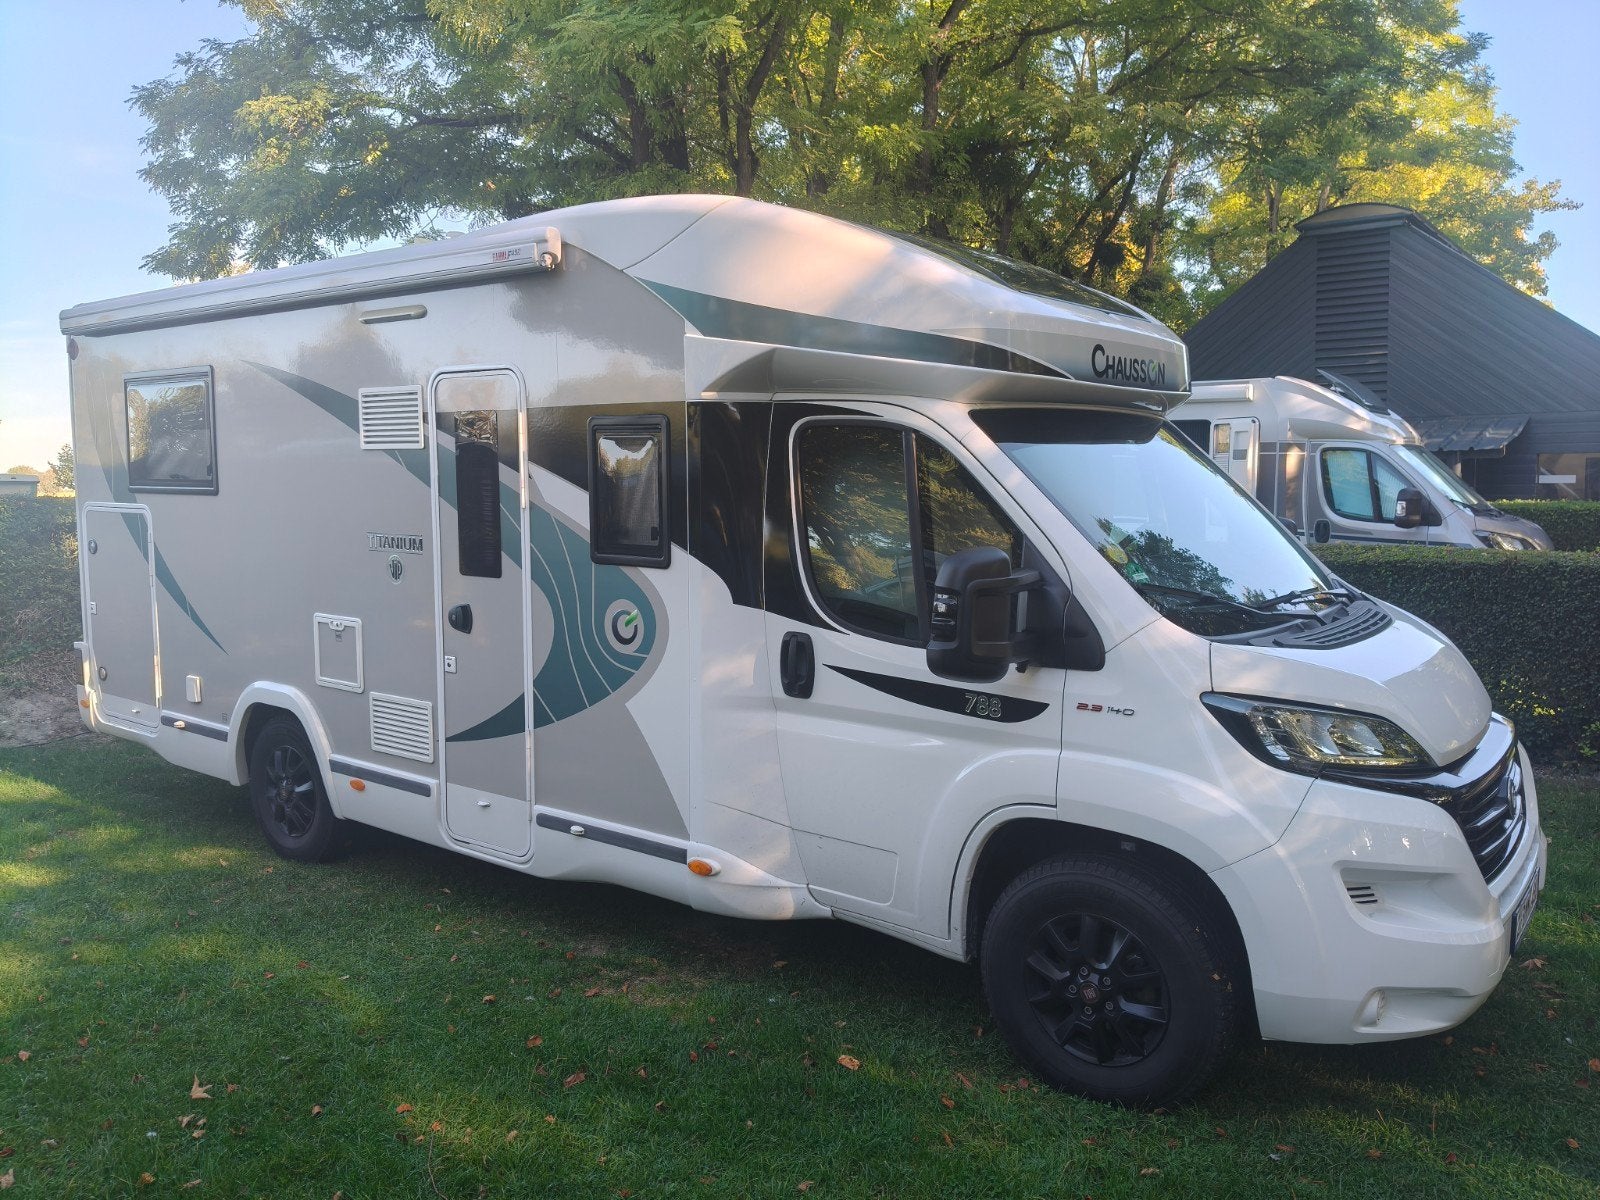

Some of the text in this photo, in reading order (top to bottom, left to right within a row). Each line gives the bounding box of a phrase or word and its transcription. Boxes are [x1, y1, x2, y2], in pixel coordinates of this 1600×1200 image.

[1091, 343, 1166, 386] CHAUSSON
[367, 533, 423, 552] TITANIUM
[964, 692, 1002, 718] 788
